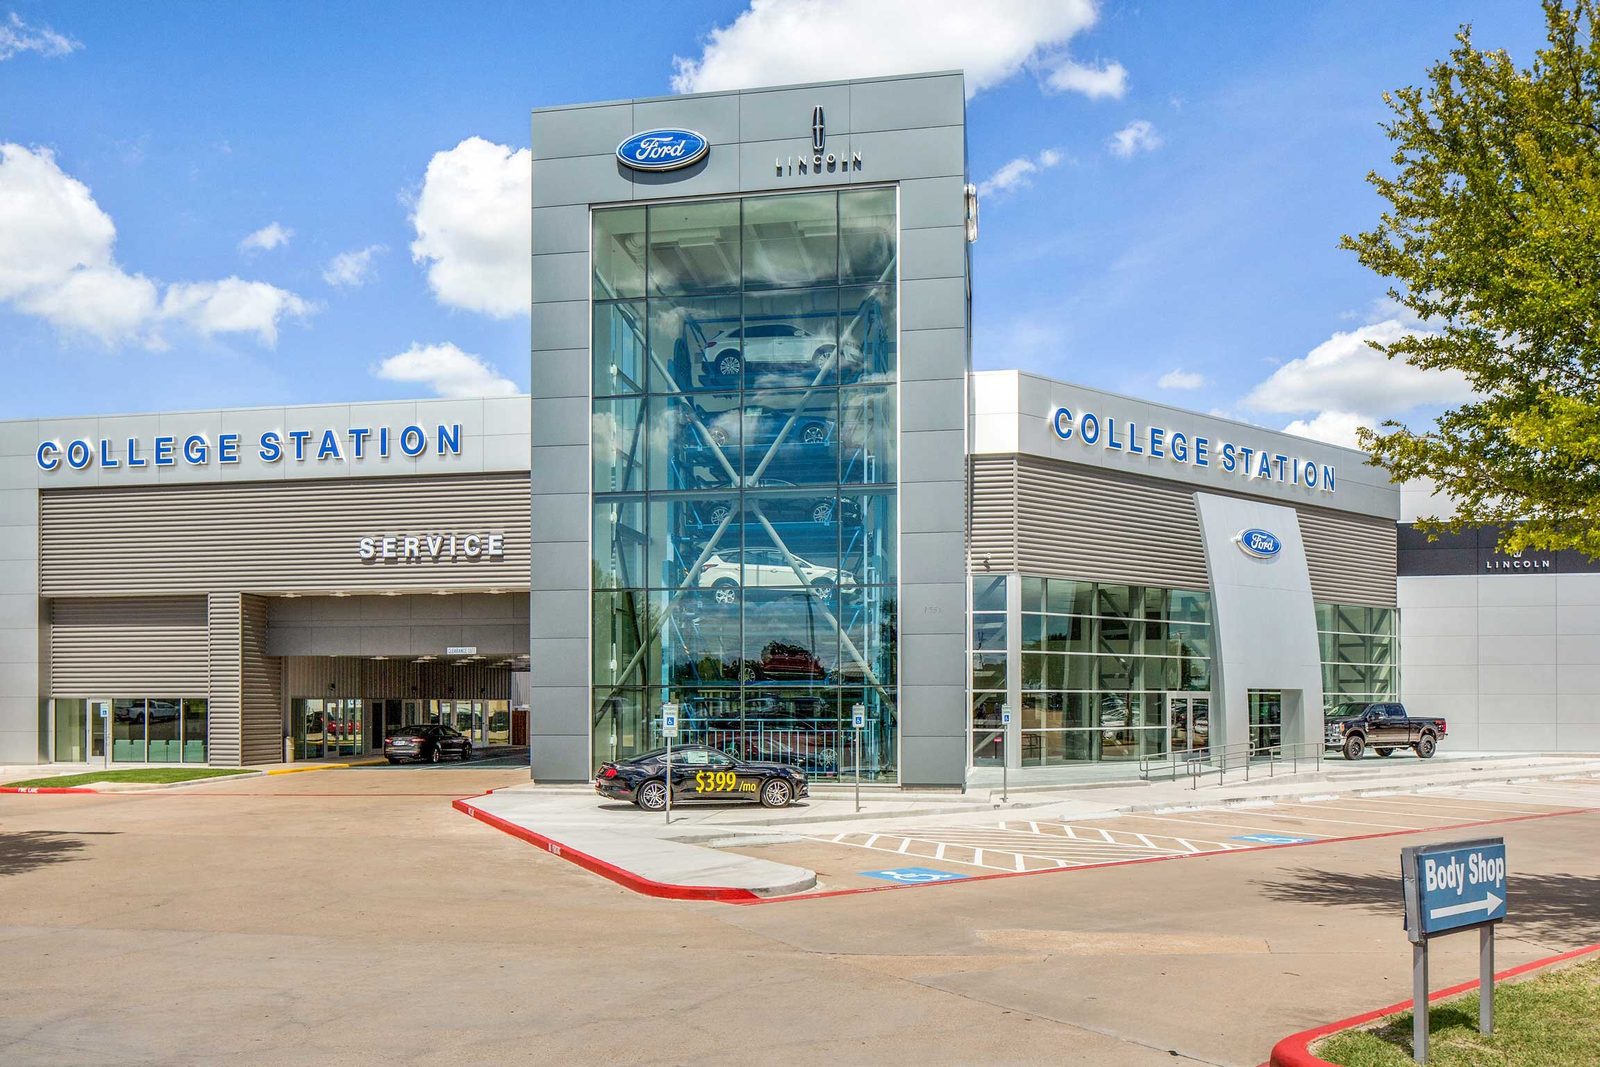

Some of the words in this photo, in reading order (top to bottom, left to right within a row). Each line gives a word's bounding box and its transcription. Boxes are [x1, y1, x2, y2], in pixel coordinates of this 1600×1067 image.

[635, 136, 686, 160] Ford
[775, 151, 862, 167] LINCOLN
[36, 433, 239, 471] COLLEGE
[258, 424, 462, 463] STATION
[1050, 407, 1209, 467] COLLEGE
[1219, 443, 1336, 492] STATION
[359, 534, 504, 559] SERVICE
[1250, 533, 1275, 551] Ford
[1486, 560, 1550, 569] LINCOLN
[695, 770, 737, 793] $399
[738, 780, 757, 792] /mo
[1425, 856, 1465, 895] Body
[1468, 853, 1504, 888] Shop
